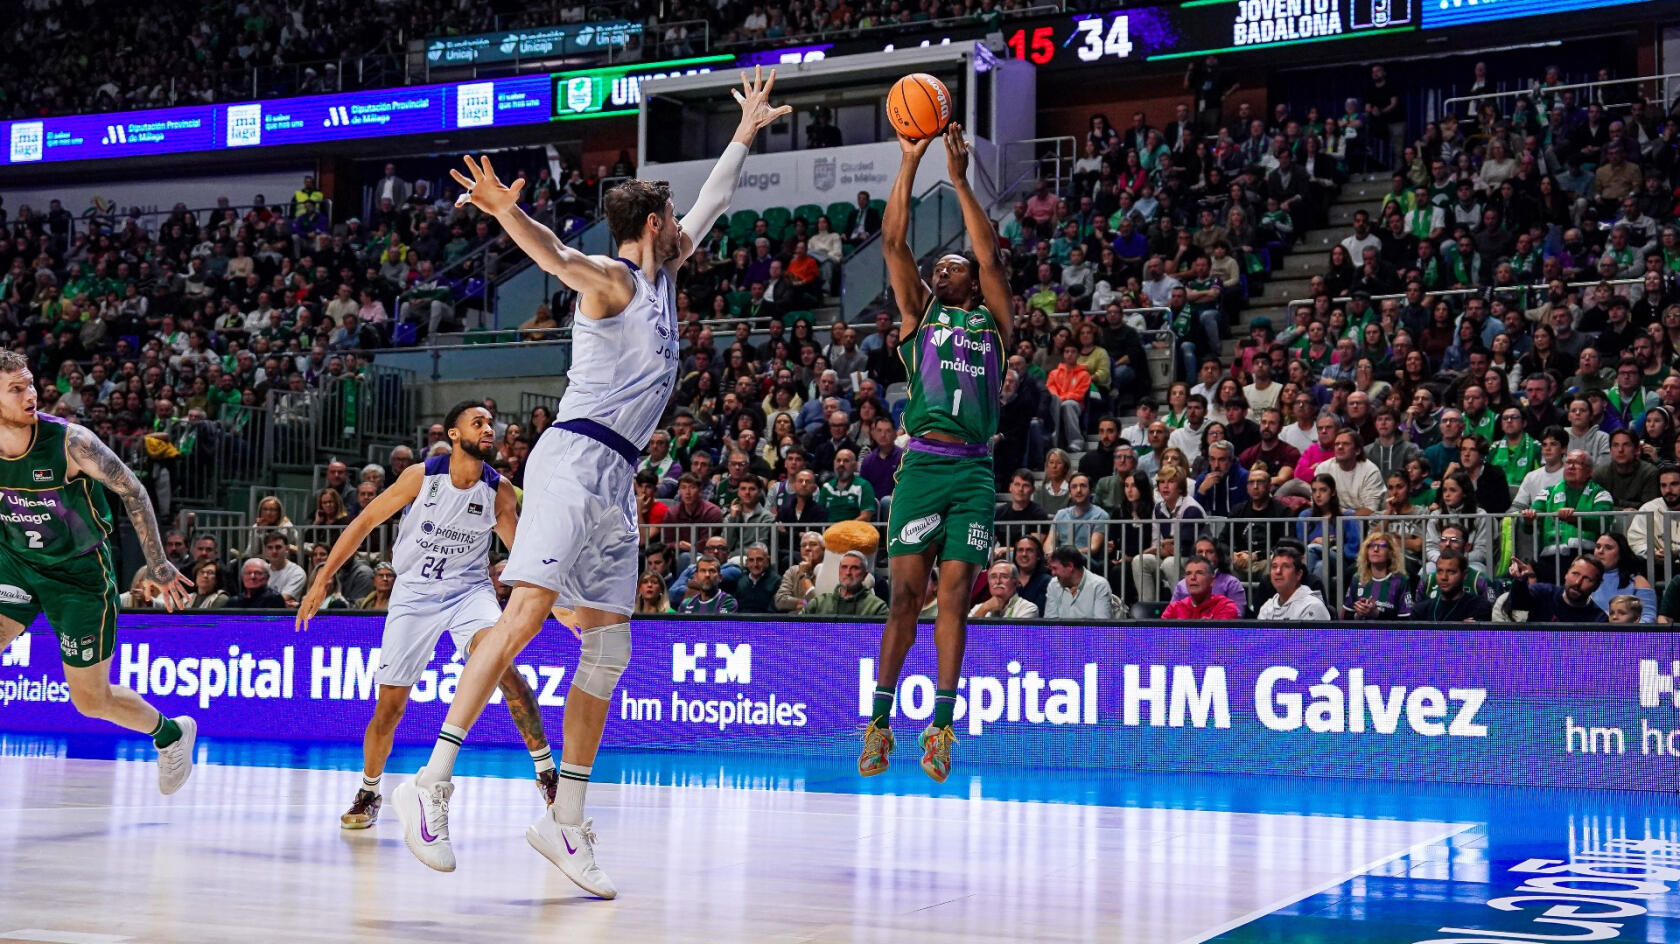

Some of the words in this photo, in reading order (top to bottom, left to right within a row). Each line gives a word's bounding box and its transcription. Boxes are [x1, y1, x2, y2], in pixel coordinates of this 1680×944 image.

[1008, 26, 1055, 64] 15
[1078, 15, 1133, 62] 34
[1233, 12, 1342, 46] BADALONA
[841, 161, 874, 172] Ciudad
[841, 174, 852, 184] de
[954, 334, 992, 355] Uncaja
[952, 388, 963, 417] 1
[0, 512, 51, 524] málaga
[25, 531, 44, 549] 2
[967, 533, 988, 551] laga
[421, 556, 447, 580] 24
[119, 643, 294, 708] Hospital
[673, 642, 752, 684] HM
[0, 674, 70, 706] pitales
[1123, 664, 1231, 729] HM
[1255, 666, 1488, 737] Gálvez
[621, 690, 662, 721] hm
[671, 690, 808, 731] hospitales
[1566, 716, 1624, 755] hm
